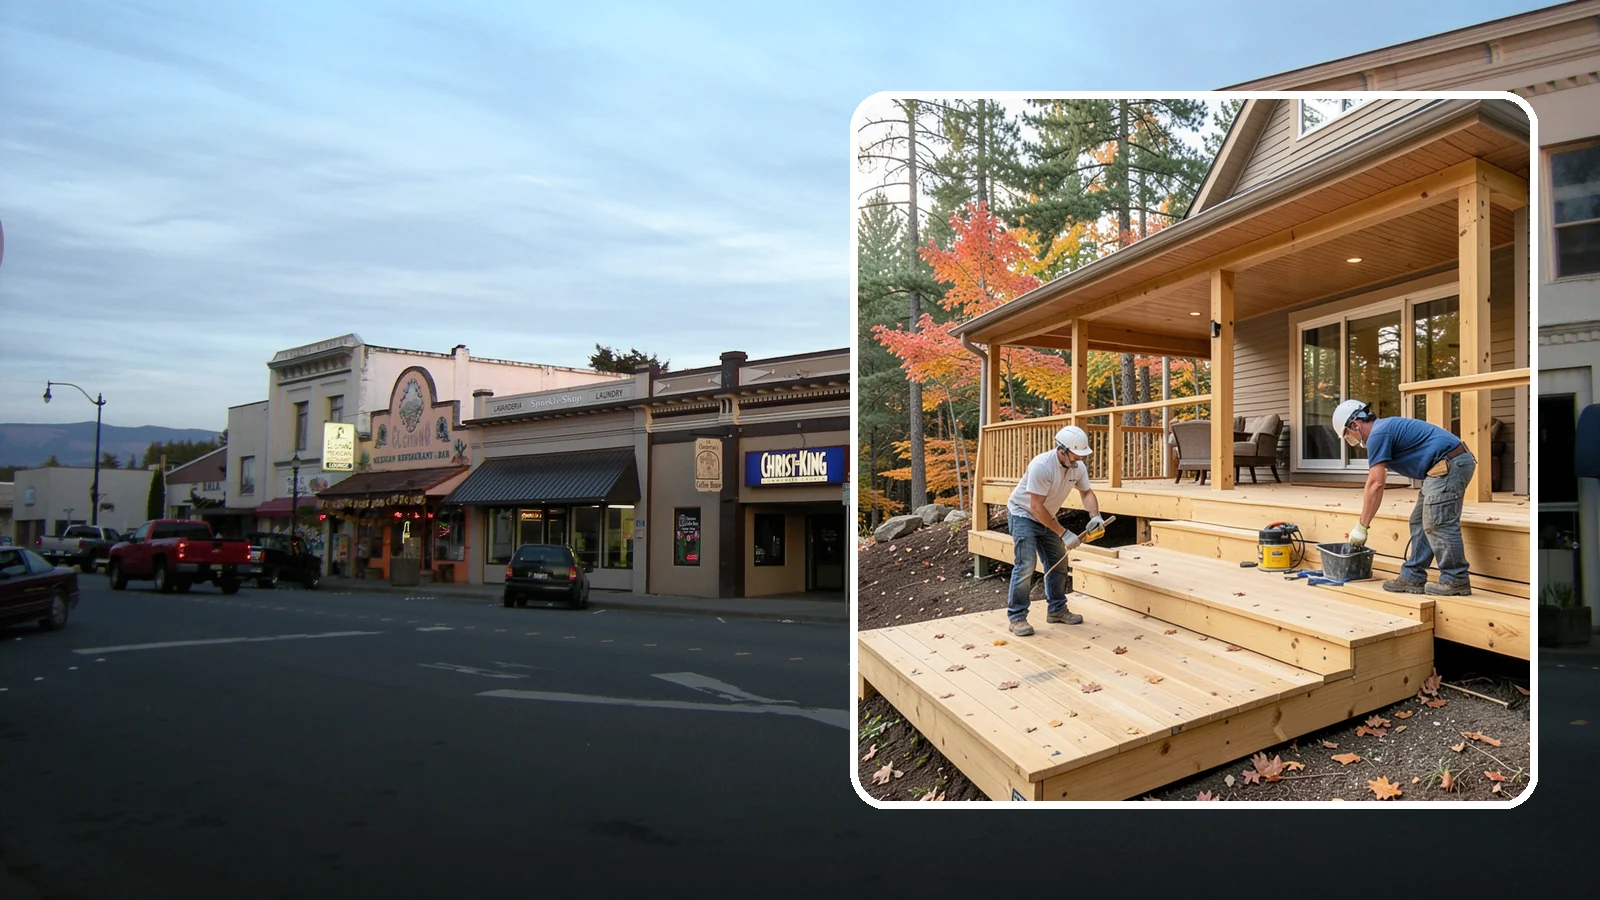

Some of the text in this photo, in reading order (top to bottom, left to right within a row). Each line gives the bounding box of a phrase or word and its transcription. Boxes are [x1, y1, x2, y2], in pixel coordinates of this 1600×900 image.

[493, 402, 522, 412] LAVANDERIA
[562, 395, 582, 403] Shop
[595, 388, 623, 400] LAUNDRY
[373, 455, 396, 464] MEXICAN
[397, 451, 433, 462] RESTAURANT
[438, 450, 450, 459] BAR
[761, 450, 827, 478] CHRIST KING
